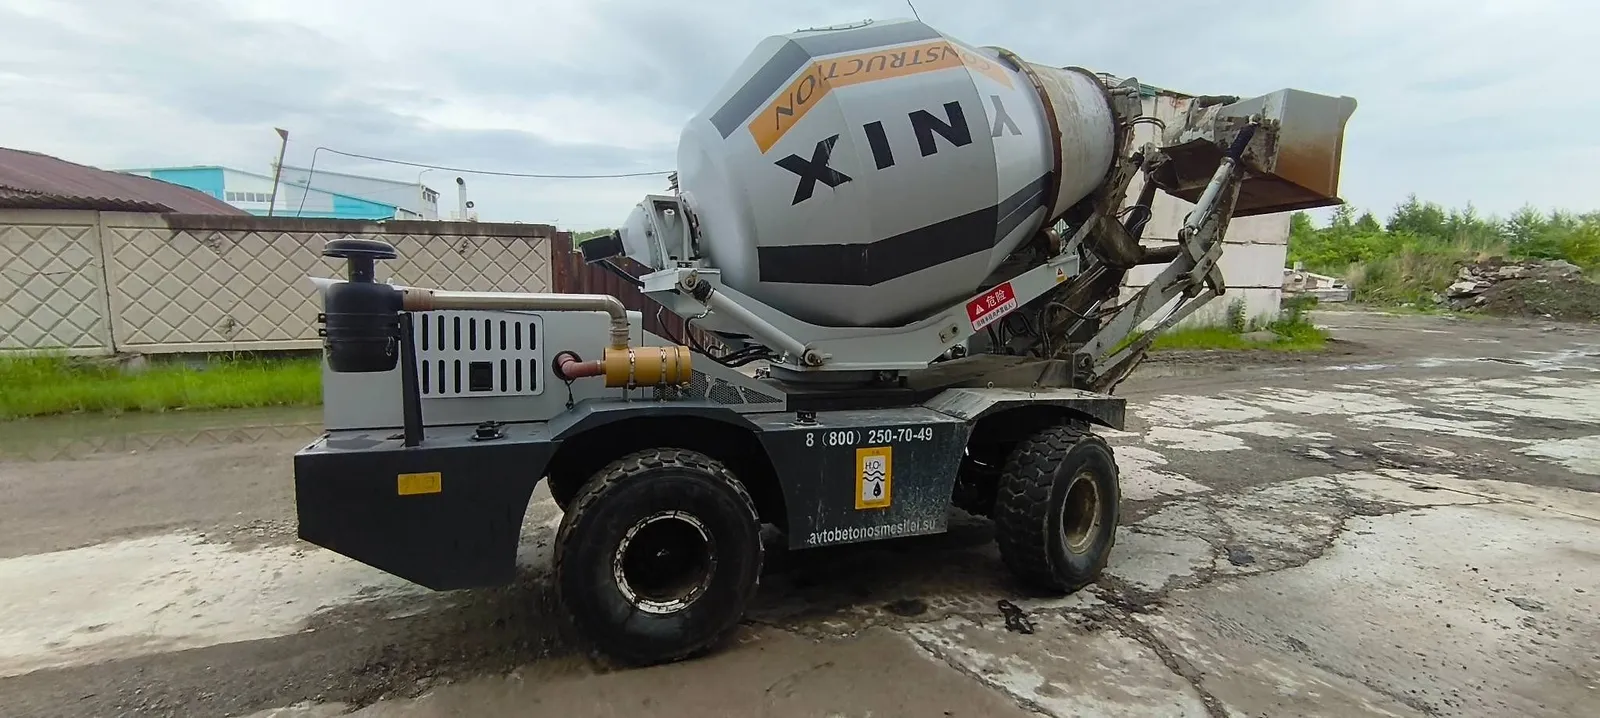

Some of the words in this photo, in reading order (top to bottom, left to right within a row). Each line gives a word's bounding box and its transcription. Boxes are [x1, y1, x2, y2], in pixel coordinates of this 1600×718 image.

[776, 45, 991, 130] CONSTRUCTION
[985, 289, 1007, 308] 危险
[805, 432, 815, 447] 8
[868, 427, 933, 444] 250-70-49
